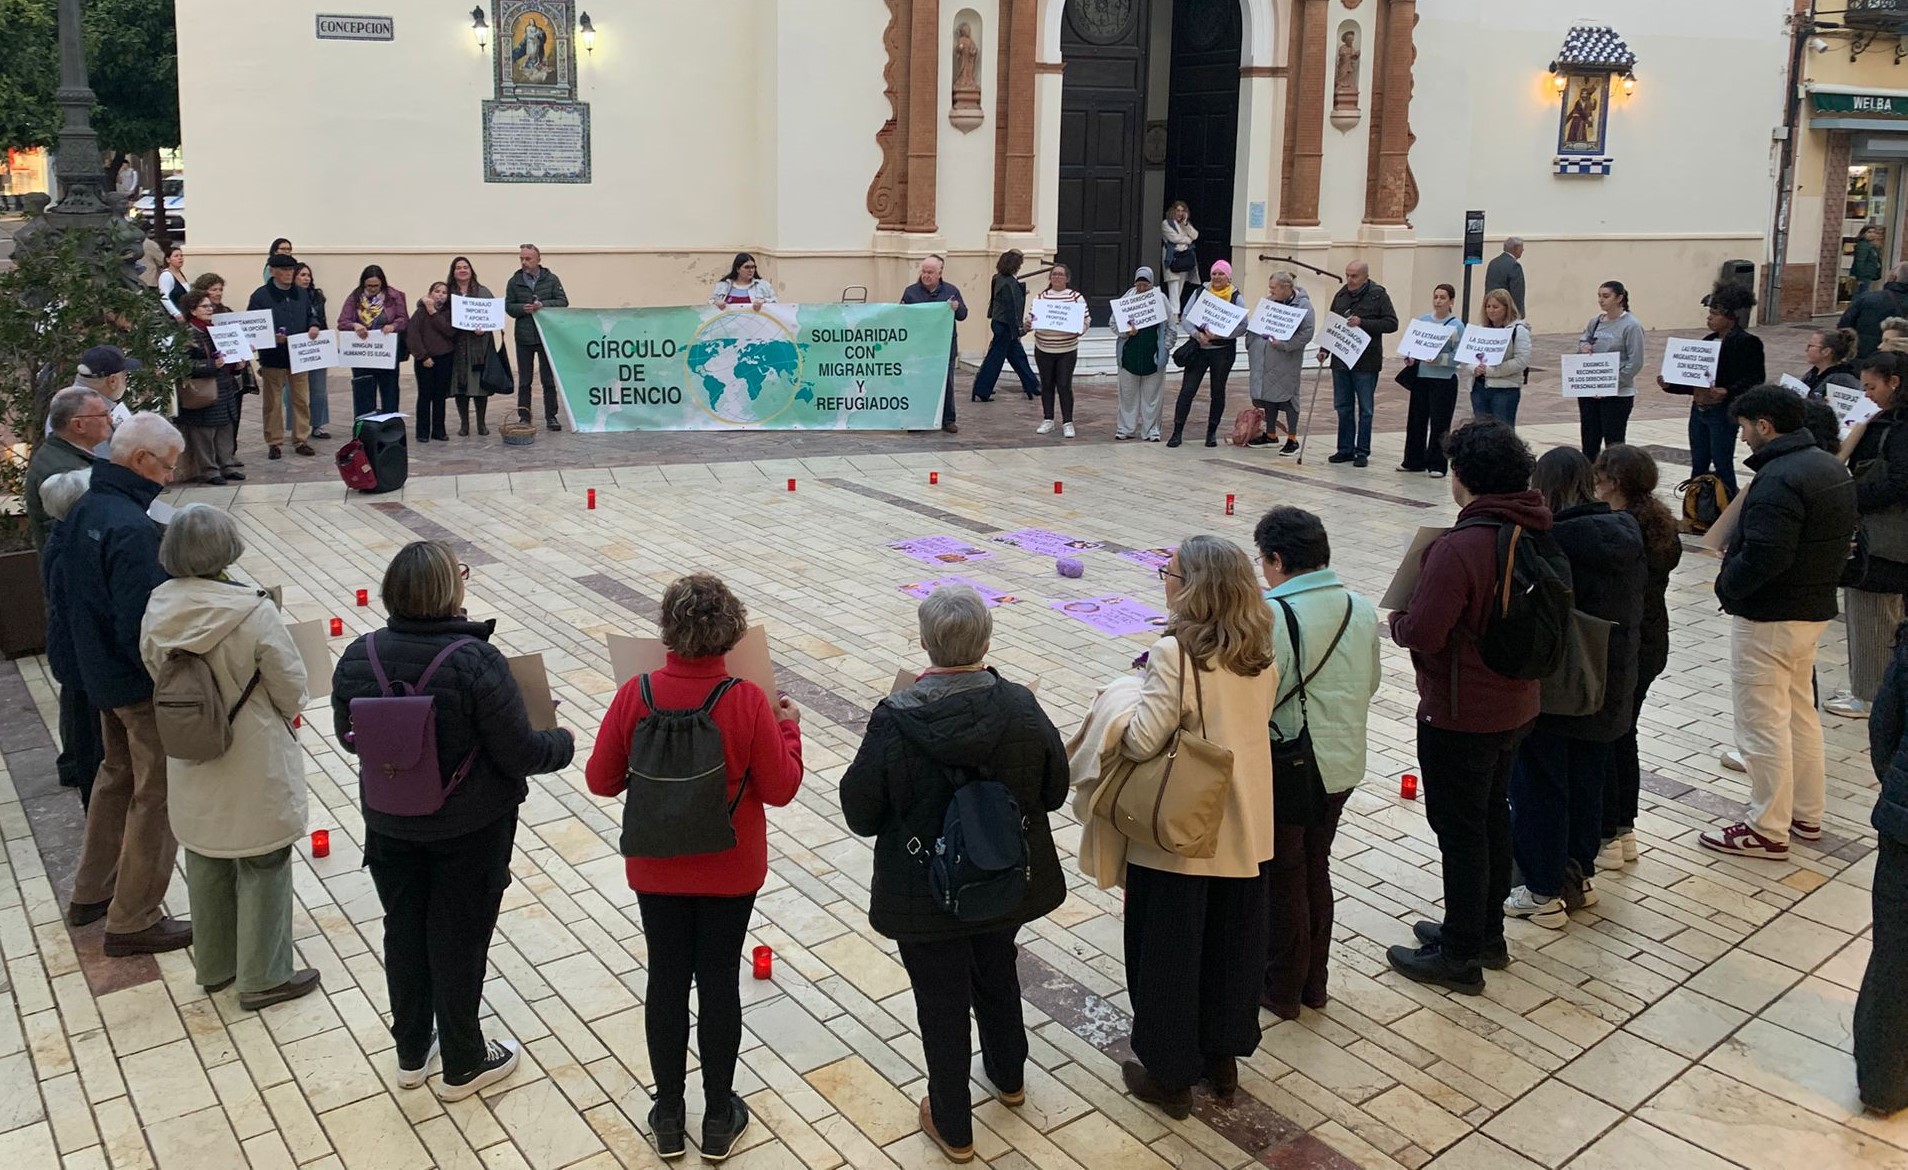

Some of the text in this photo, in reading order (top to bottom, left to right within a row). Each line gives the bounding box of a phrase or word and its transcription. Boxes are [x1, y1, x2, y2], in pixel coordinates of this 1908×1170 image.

[1853, 96, 1892, 110] WELBA
[1334, 322, 1342, 330] LA
[811, 328, 908, 343] SOLIDARIDAD
[586, 335, 677, 360] CÍRCULO
[844, 346, 876, 360] CON
[619, 364, 646, 382] DE
[819, 362, 903, 378] MIGRANTES
[856, 380, 865, 393] Y
[588, 386, 682, 406] SILENCIO
[816, 396, 910, 411] REFUGIADOS
